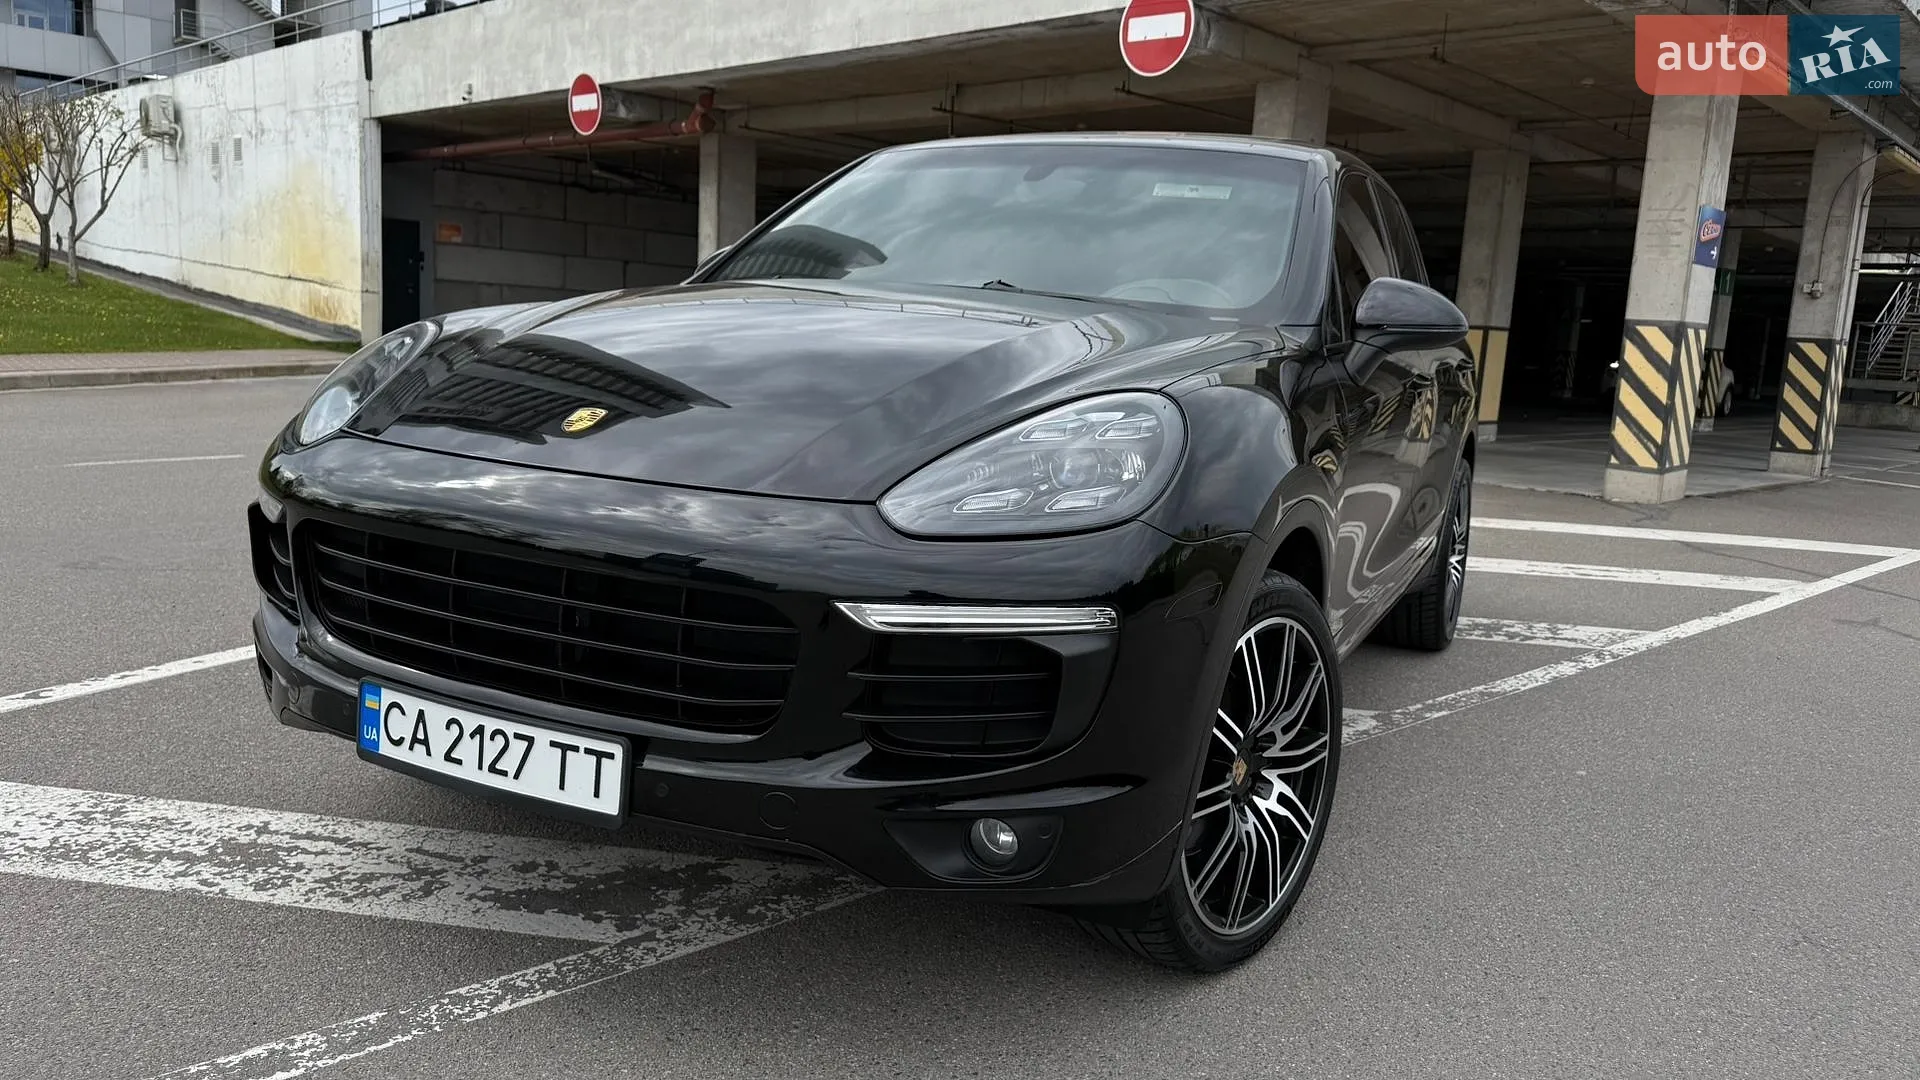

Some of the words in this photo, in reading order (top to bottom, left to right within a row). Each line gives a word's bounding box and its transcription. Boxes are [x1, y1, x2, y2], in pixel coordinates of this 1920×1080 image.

[363, 724, 378, 742] UA
[383, 701, 432, 757] CA
[443, 717, 535, 781] 2127
[549, 739, 615, 799] TT
